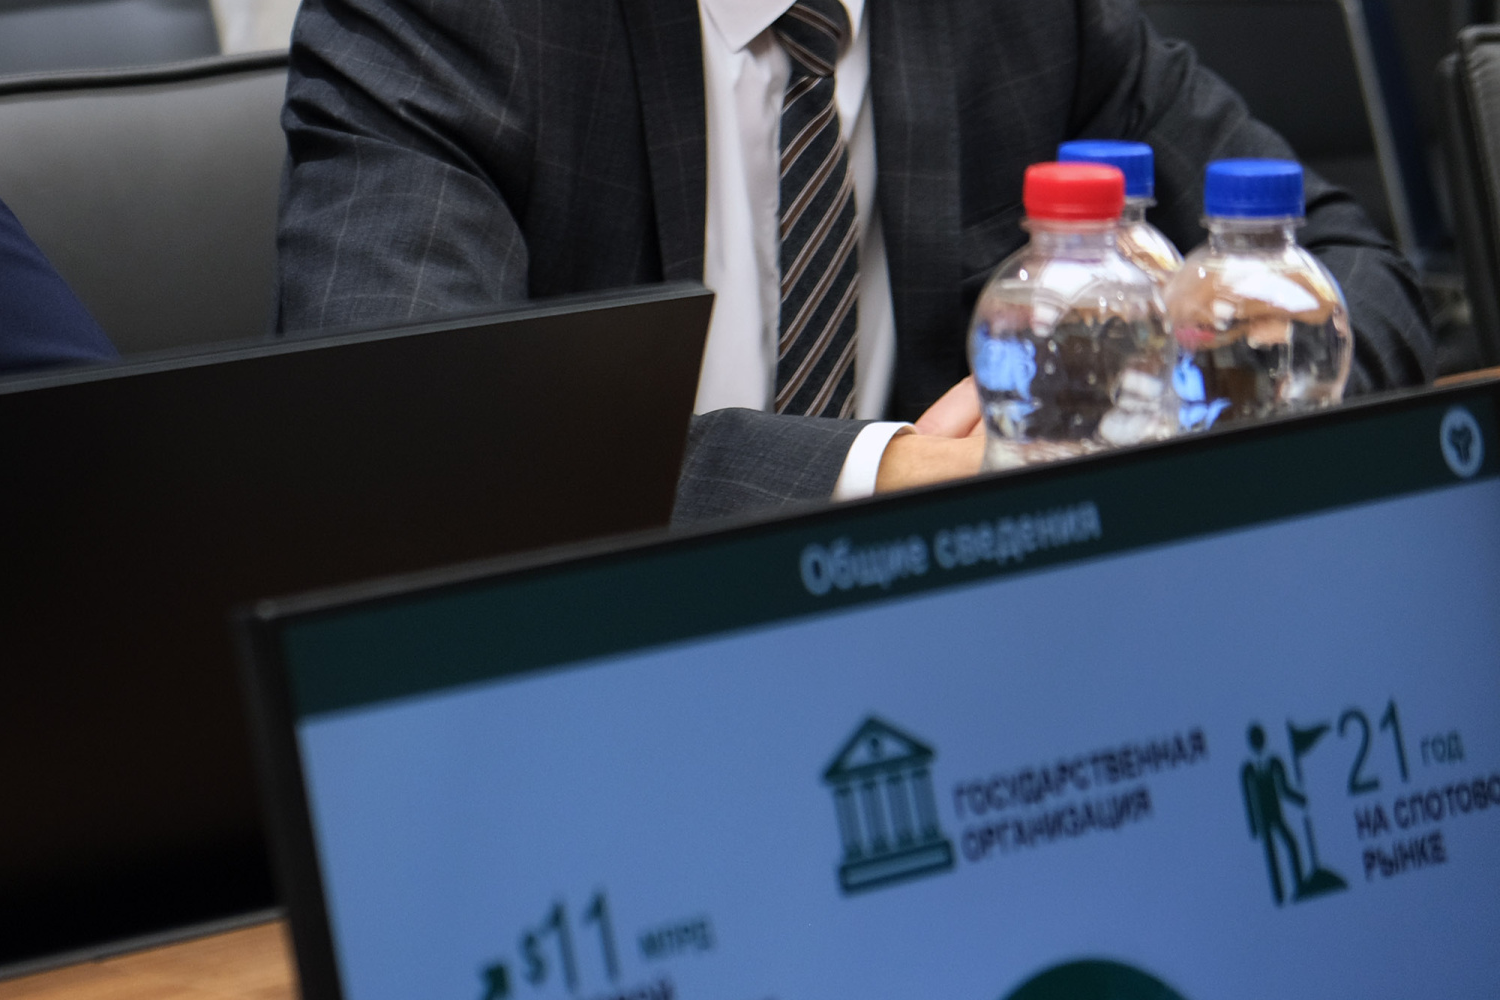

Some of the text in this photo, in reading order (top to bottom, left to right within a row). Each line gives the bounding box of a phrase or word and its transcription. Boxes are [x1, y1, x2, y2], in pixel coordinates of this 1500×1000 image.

[800, 501, 1101, 596] Общие сведения
[953, 728, 1208, 817] ГОСУДАРСТВЕННАЯ
[1337, 696, 1465, 796] 21 год
[960, 785, 1154, 863] ОРГАНИЗАЦИЯ
[1354, 803, 1390, 840] НА
[1362, 829, 1447, 882] РЫНКЕ
